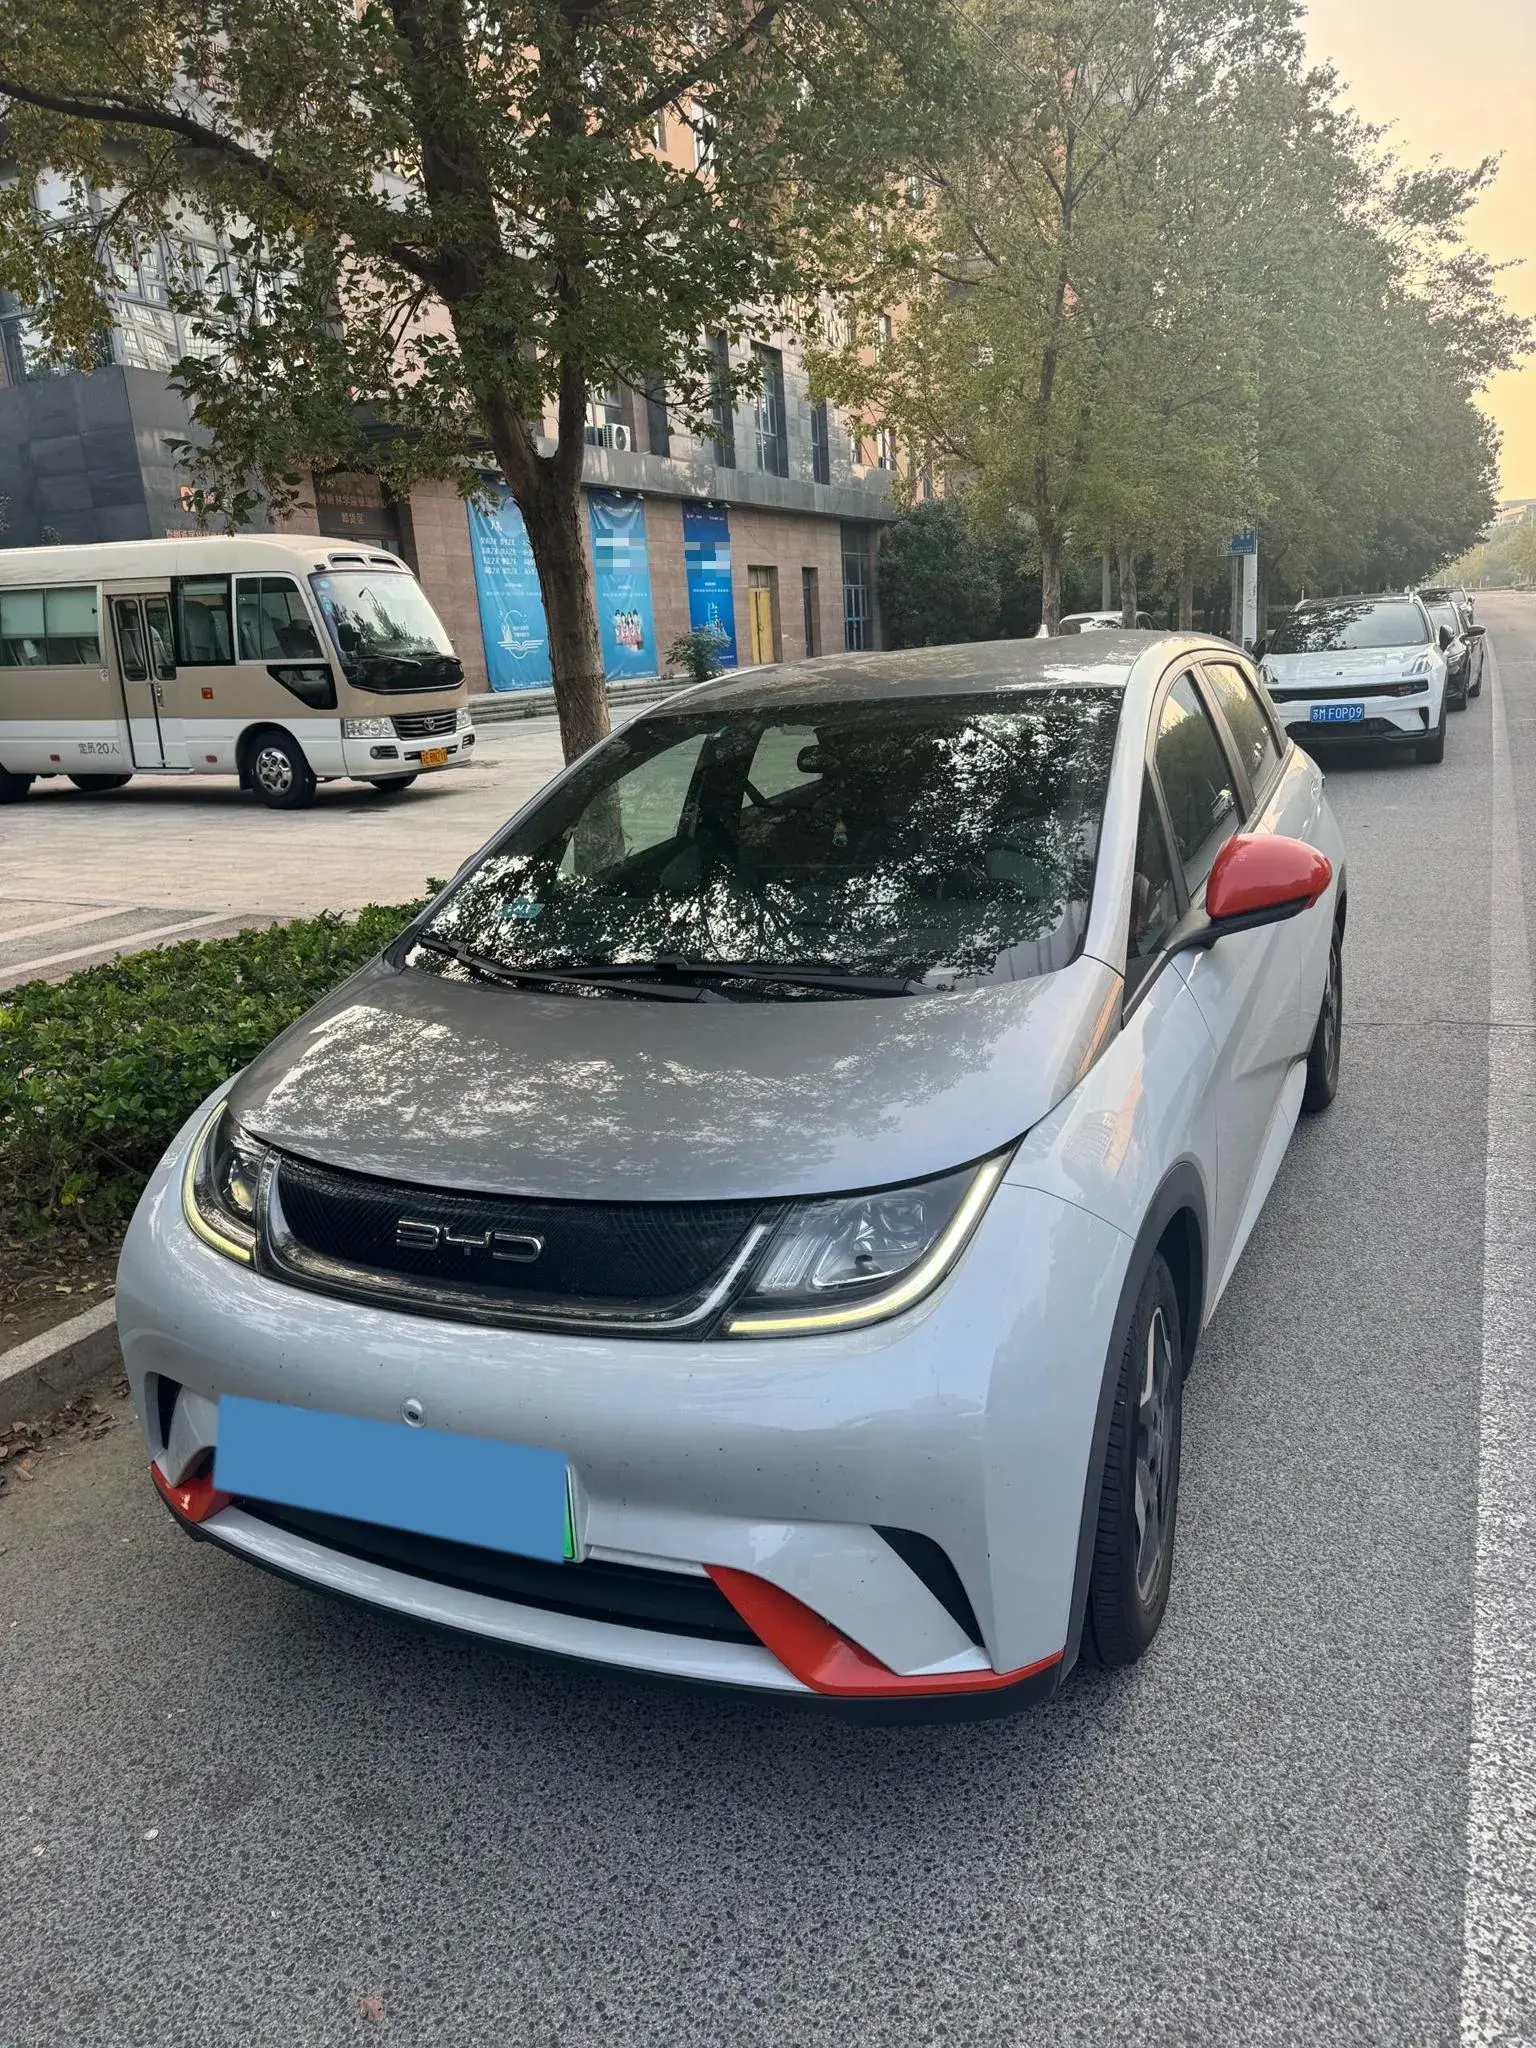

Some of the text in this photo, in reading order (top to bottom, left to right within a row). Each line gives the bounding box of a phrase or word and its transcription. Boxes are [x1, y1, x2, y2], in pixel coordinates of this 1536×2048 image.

[79, 742, 119, 754] 定员20人
[396, 1217, 545, 1262] BYD
